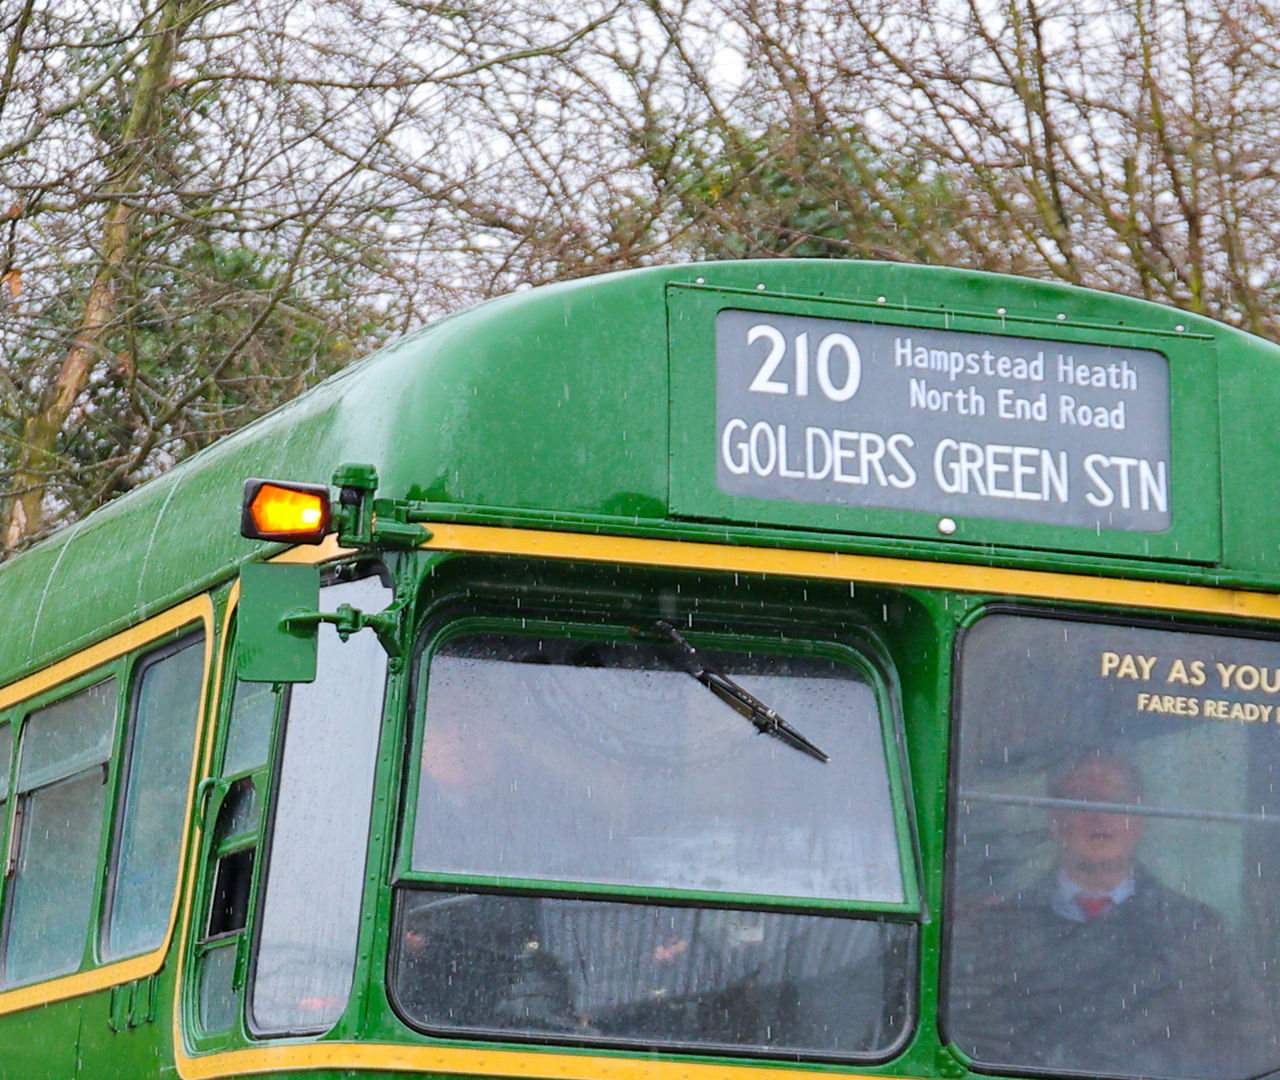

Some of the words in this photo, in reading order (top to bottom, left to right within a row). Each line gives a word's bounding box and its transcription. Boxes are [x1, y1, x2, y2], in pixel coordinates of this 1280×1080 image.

[746, 323, 862, 402] 210
[894, 336, 1045, 383] Hampstead
[1057, 353, 1138, 391] Heath
[909, 377, 986, 418] North
[998, 388, 1048, 422] End
[1059, 398, 1126, 431] Road
[721, 418, 917, 489] GOLDERS
[933, 437, 1069, 504] GREEN
[1084, 453, 1169, 513] STN
[1101, 651, 1157, 681] PAY
[1167, 658, 1207, 687] AS
[1137, 692, 1200, 718] FARES
[1203, 698, 1273, 724] READY
